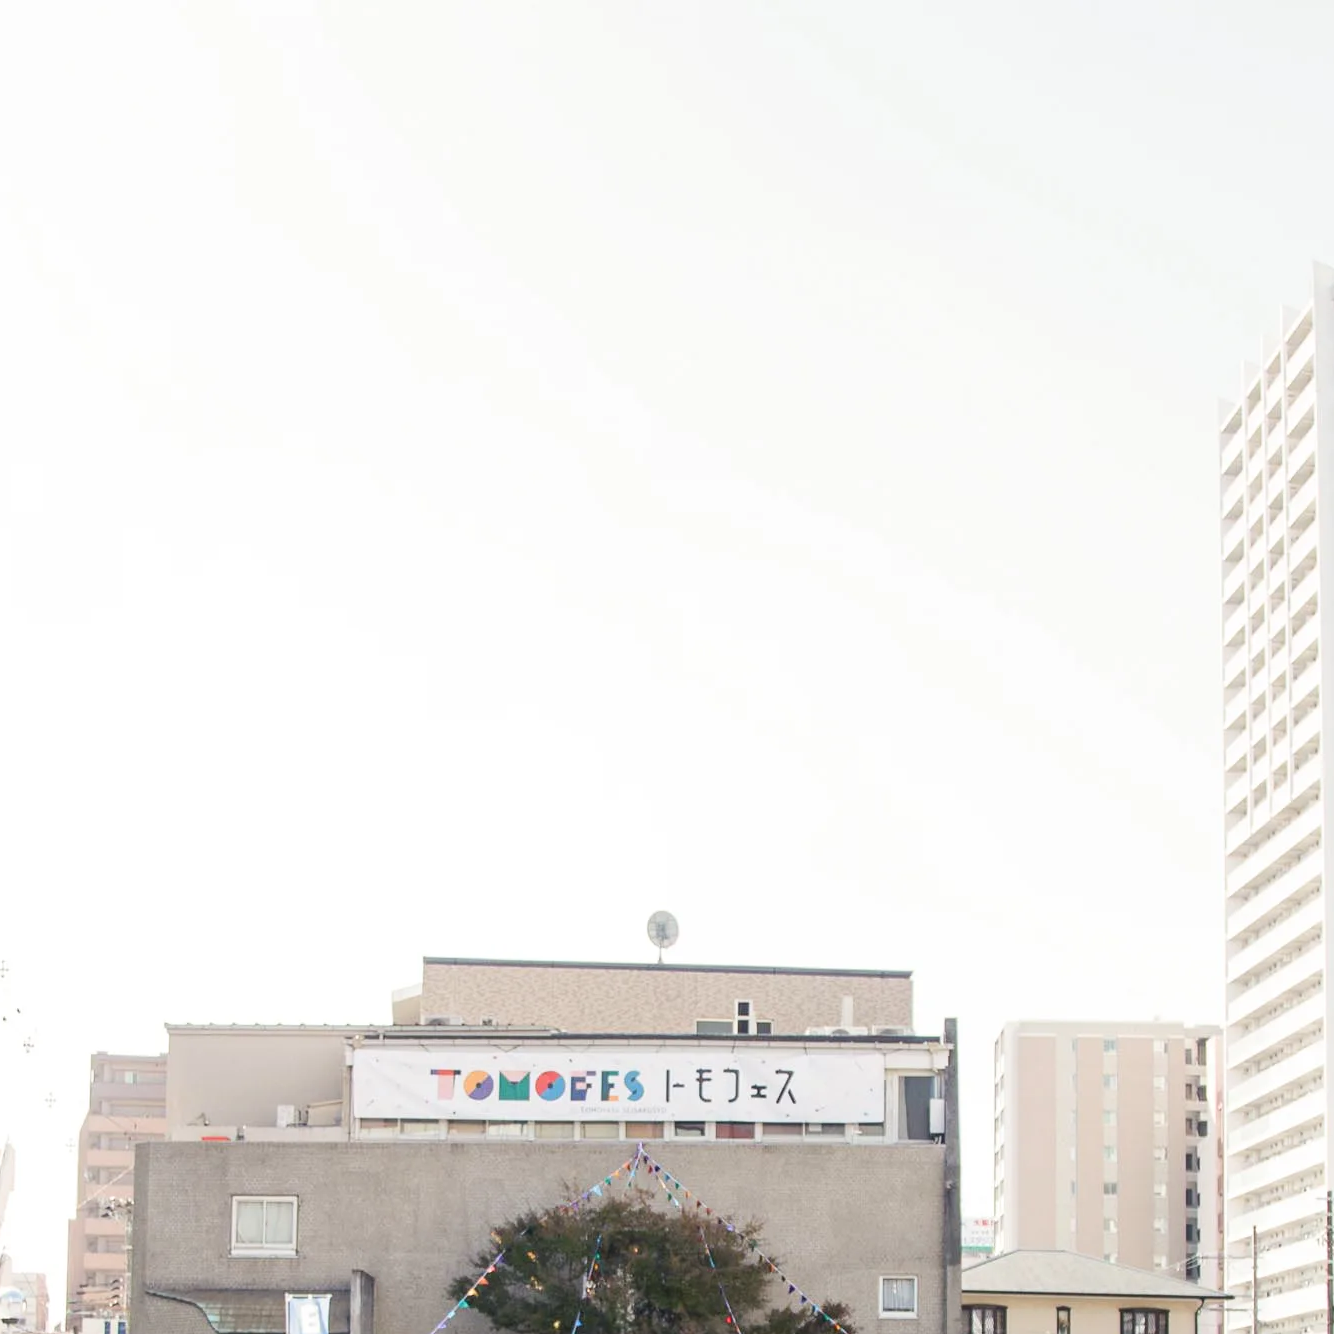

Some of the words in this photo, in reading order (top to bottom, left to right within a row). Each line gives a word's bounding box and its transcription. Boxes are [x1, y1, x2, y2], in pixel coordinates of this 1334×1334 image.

[430, 1069, 644, 1101] TOMOFES
[665, 1068, 797, 1104] トモフェス
